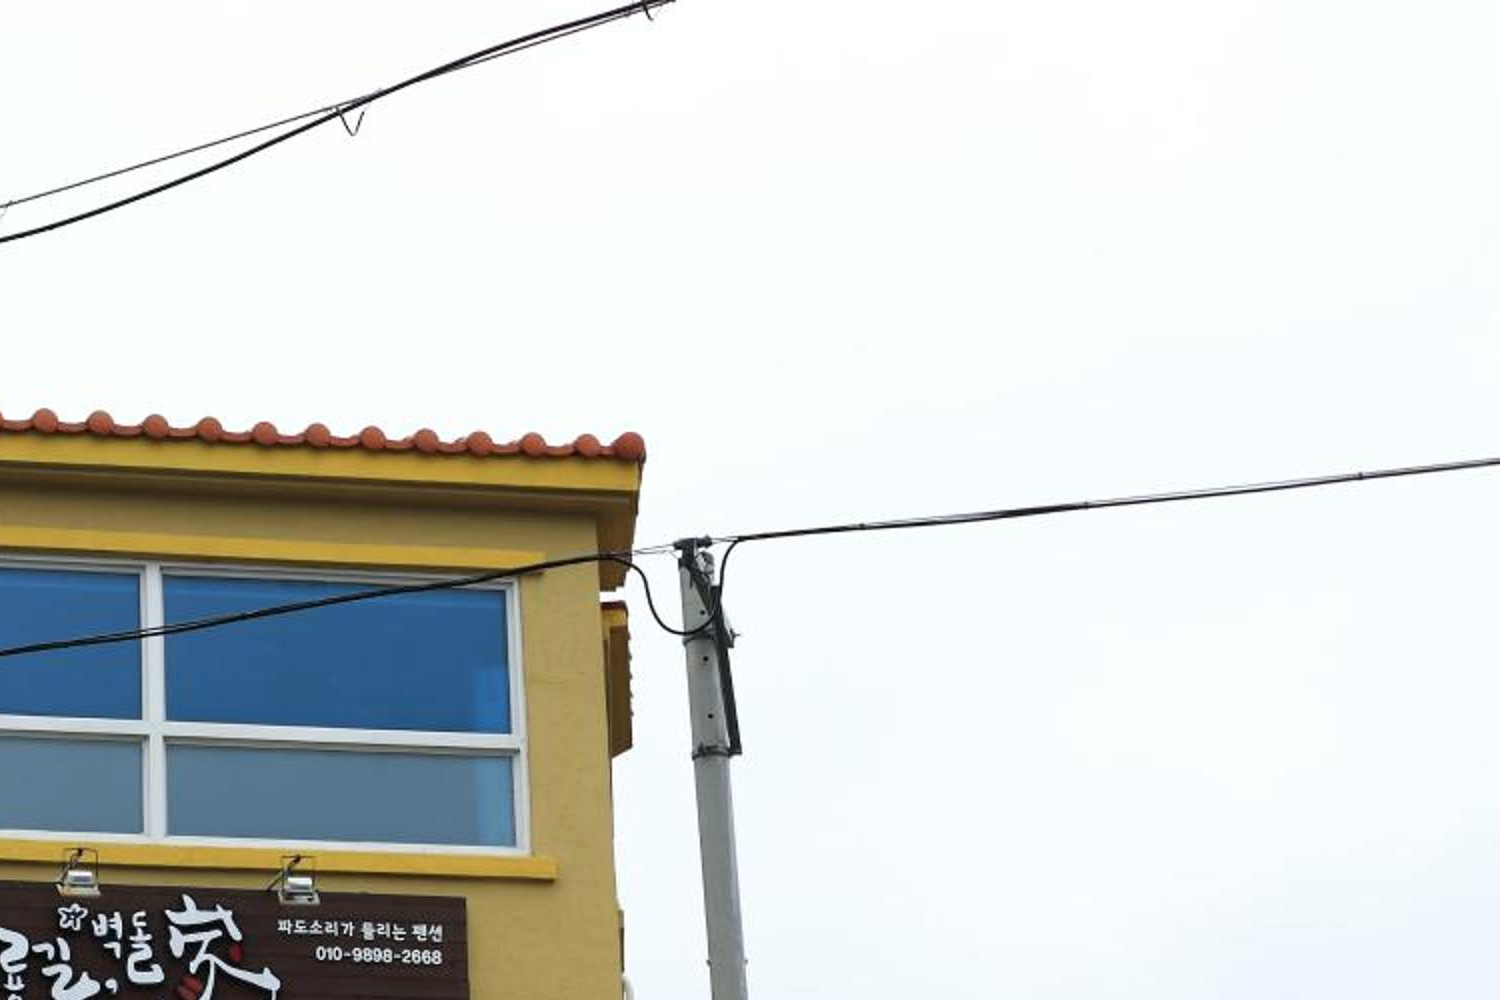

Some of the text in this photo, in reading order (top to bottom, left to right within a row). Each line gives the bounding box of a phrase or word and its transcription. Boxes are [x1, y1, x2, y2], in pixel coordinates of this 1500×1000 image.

[277, 919, 355, 937] 파도소리가
[361, 921, 407, 940] 들리는
[315, 946, 443, 965] 010-9898-2668
